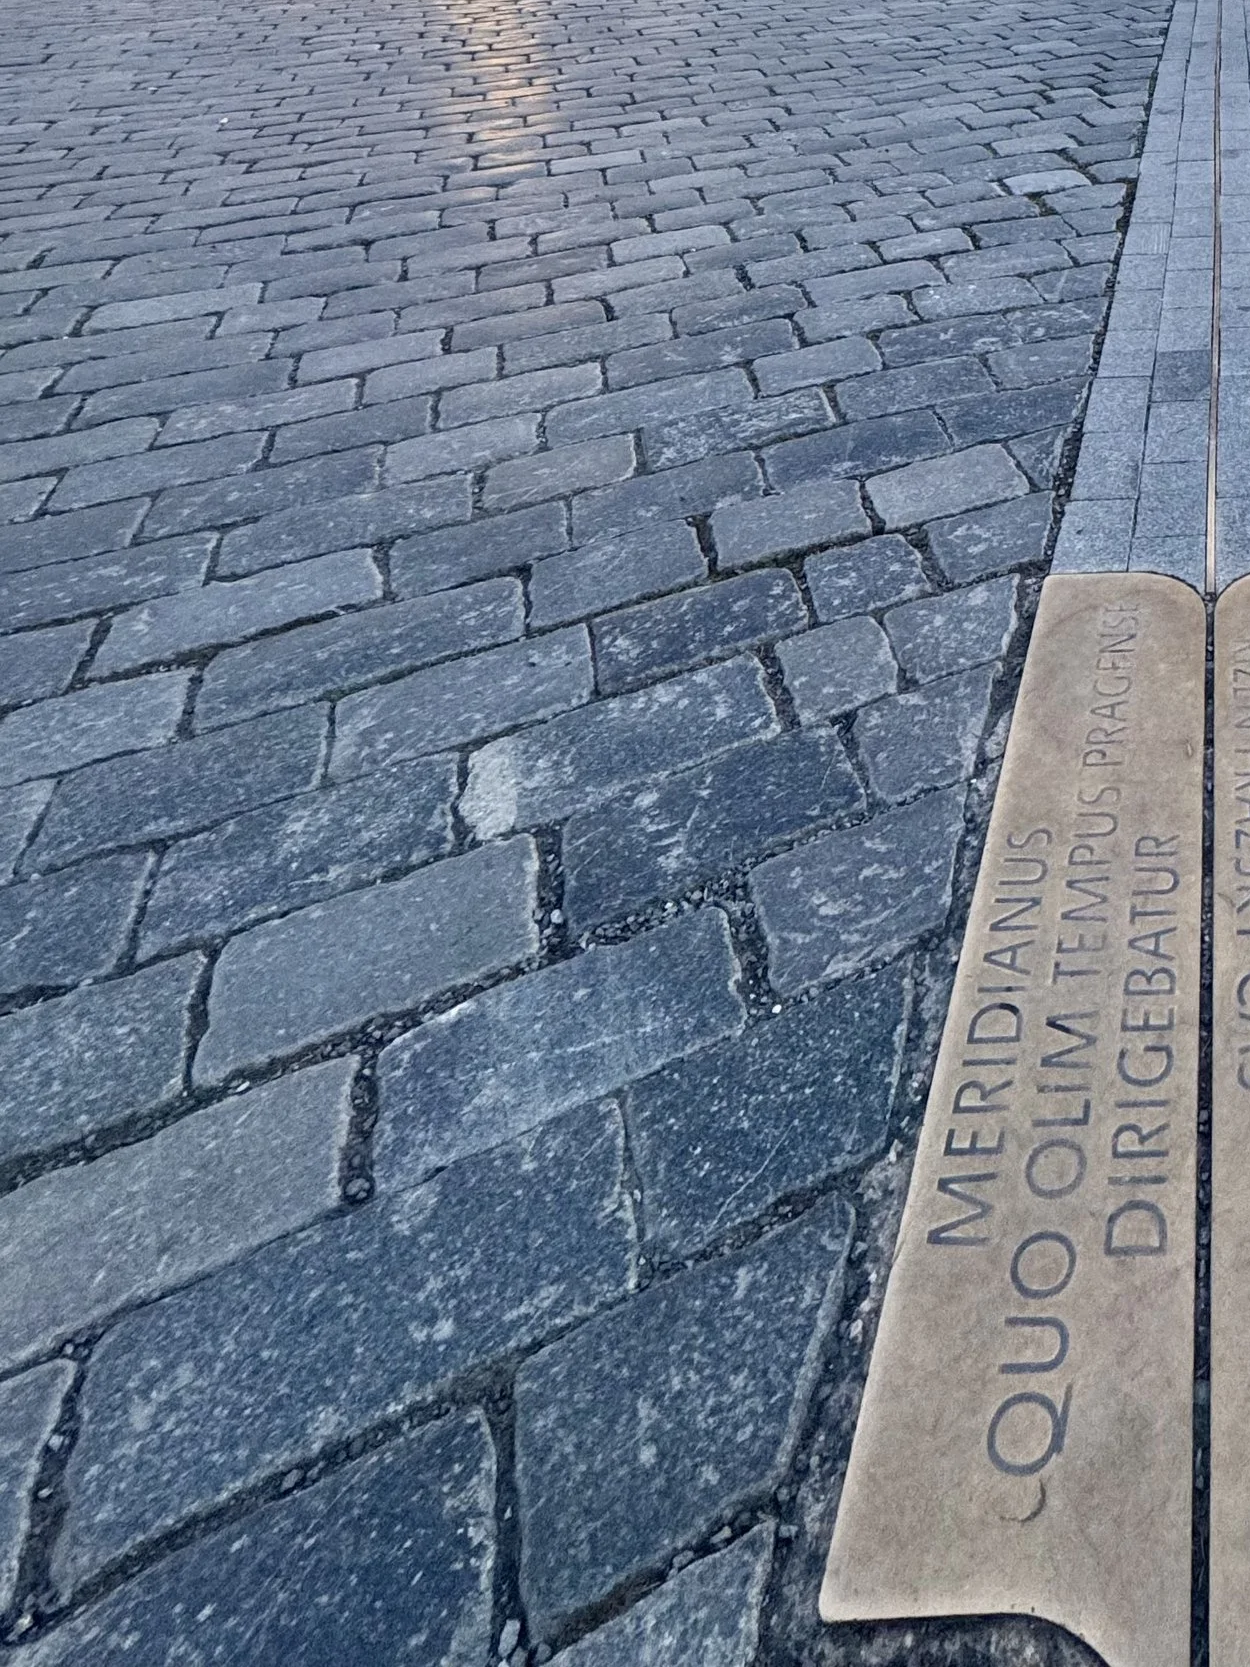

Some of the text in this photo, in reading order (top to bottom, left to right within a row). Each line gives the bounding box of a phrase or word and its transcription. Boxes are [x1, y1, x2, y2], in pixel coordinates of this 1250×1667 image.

[925, 828, 1054, 1246] MERIDIANUS
[986, 601, 1141, 1476] QUO OLIM TEMPUS PRAGENSE
[1103, 833, 1181, 1257] DIRIGEBATUR
